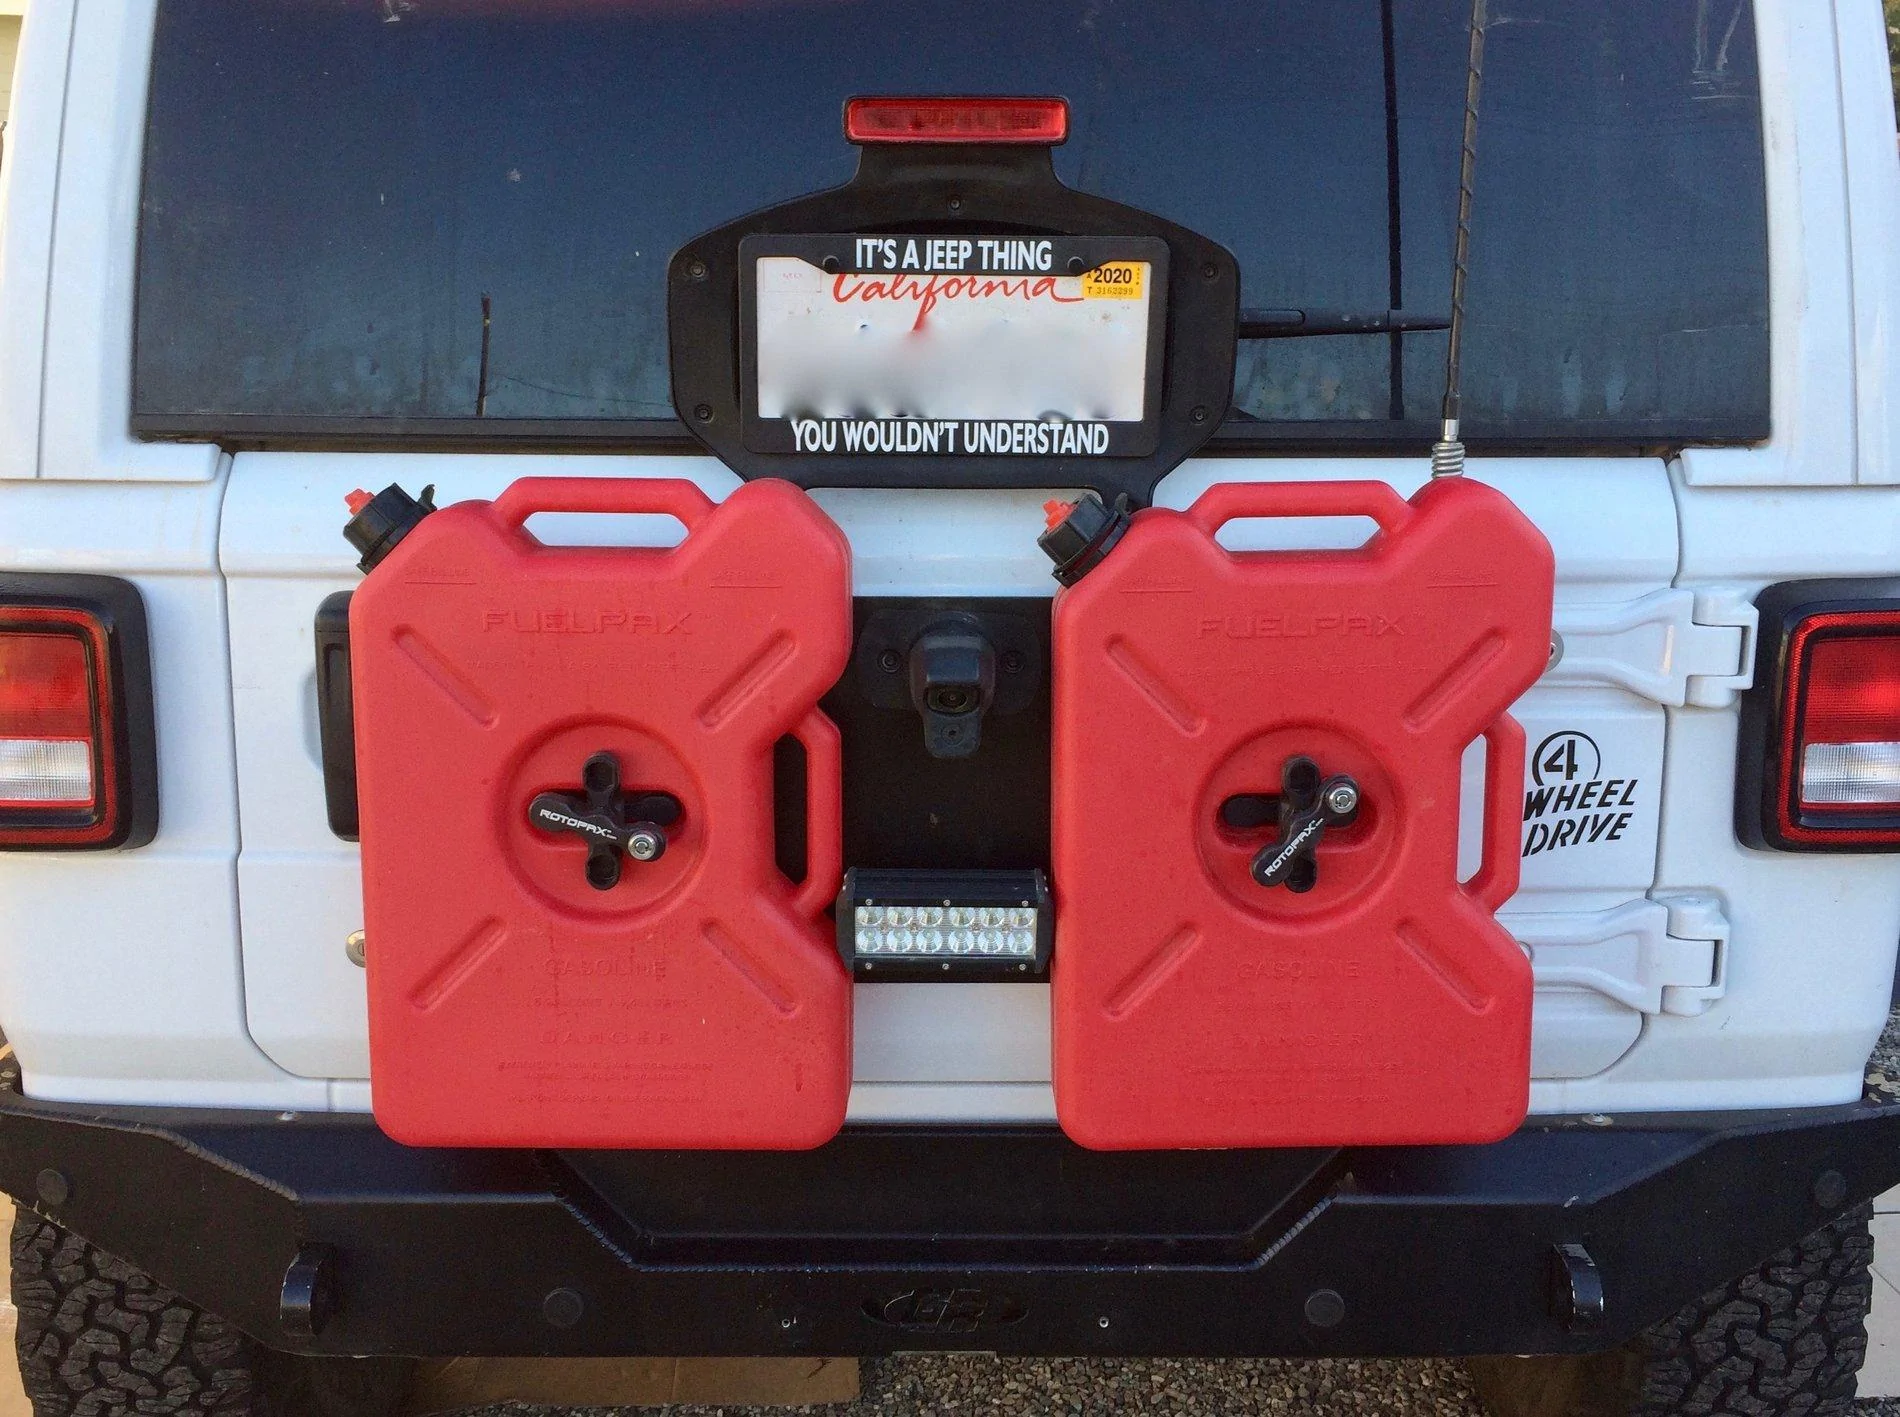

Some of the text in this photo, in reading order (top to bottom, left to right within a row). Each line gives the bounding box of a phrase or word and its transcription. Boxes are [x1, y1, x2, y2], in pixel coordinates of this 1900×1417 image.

[855, 238, 1052, 272] IT'S A JEEP THING
[1093, 267, 1132, 284] 2020
[833, 274, 1084, 331] California
[791, 420, 1109, 454] YOU WOULDN'T UNDERSTAND
[484, 609, 693, 634] FUELPAX
[1198, 615, 1404, 640] FUELPAX
[1522, 779, 1639, 822] WHEEL
[539, 808, 608, 837] ROTOPAX
[1521, 812, 1634, 858] DRIVE
[1264, 819, 1317, 877] ROTOPAX
[543, 958, 667, 977] GASOLINE
